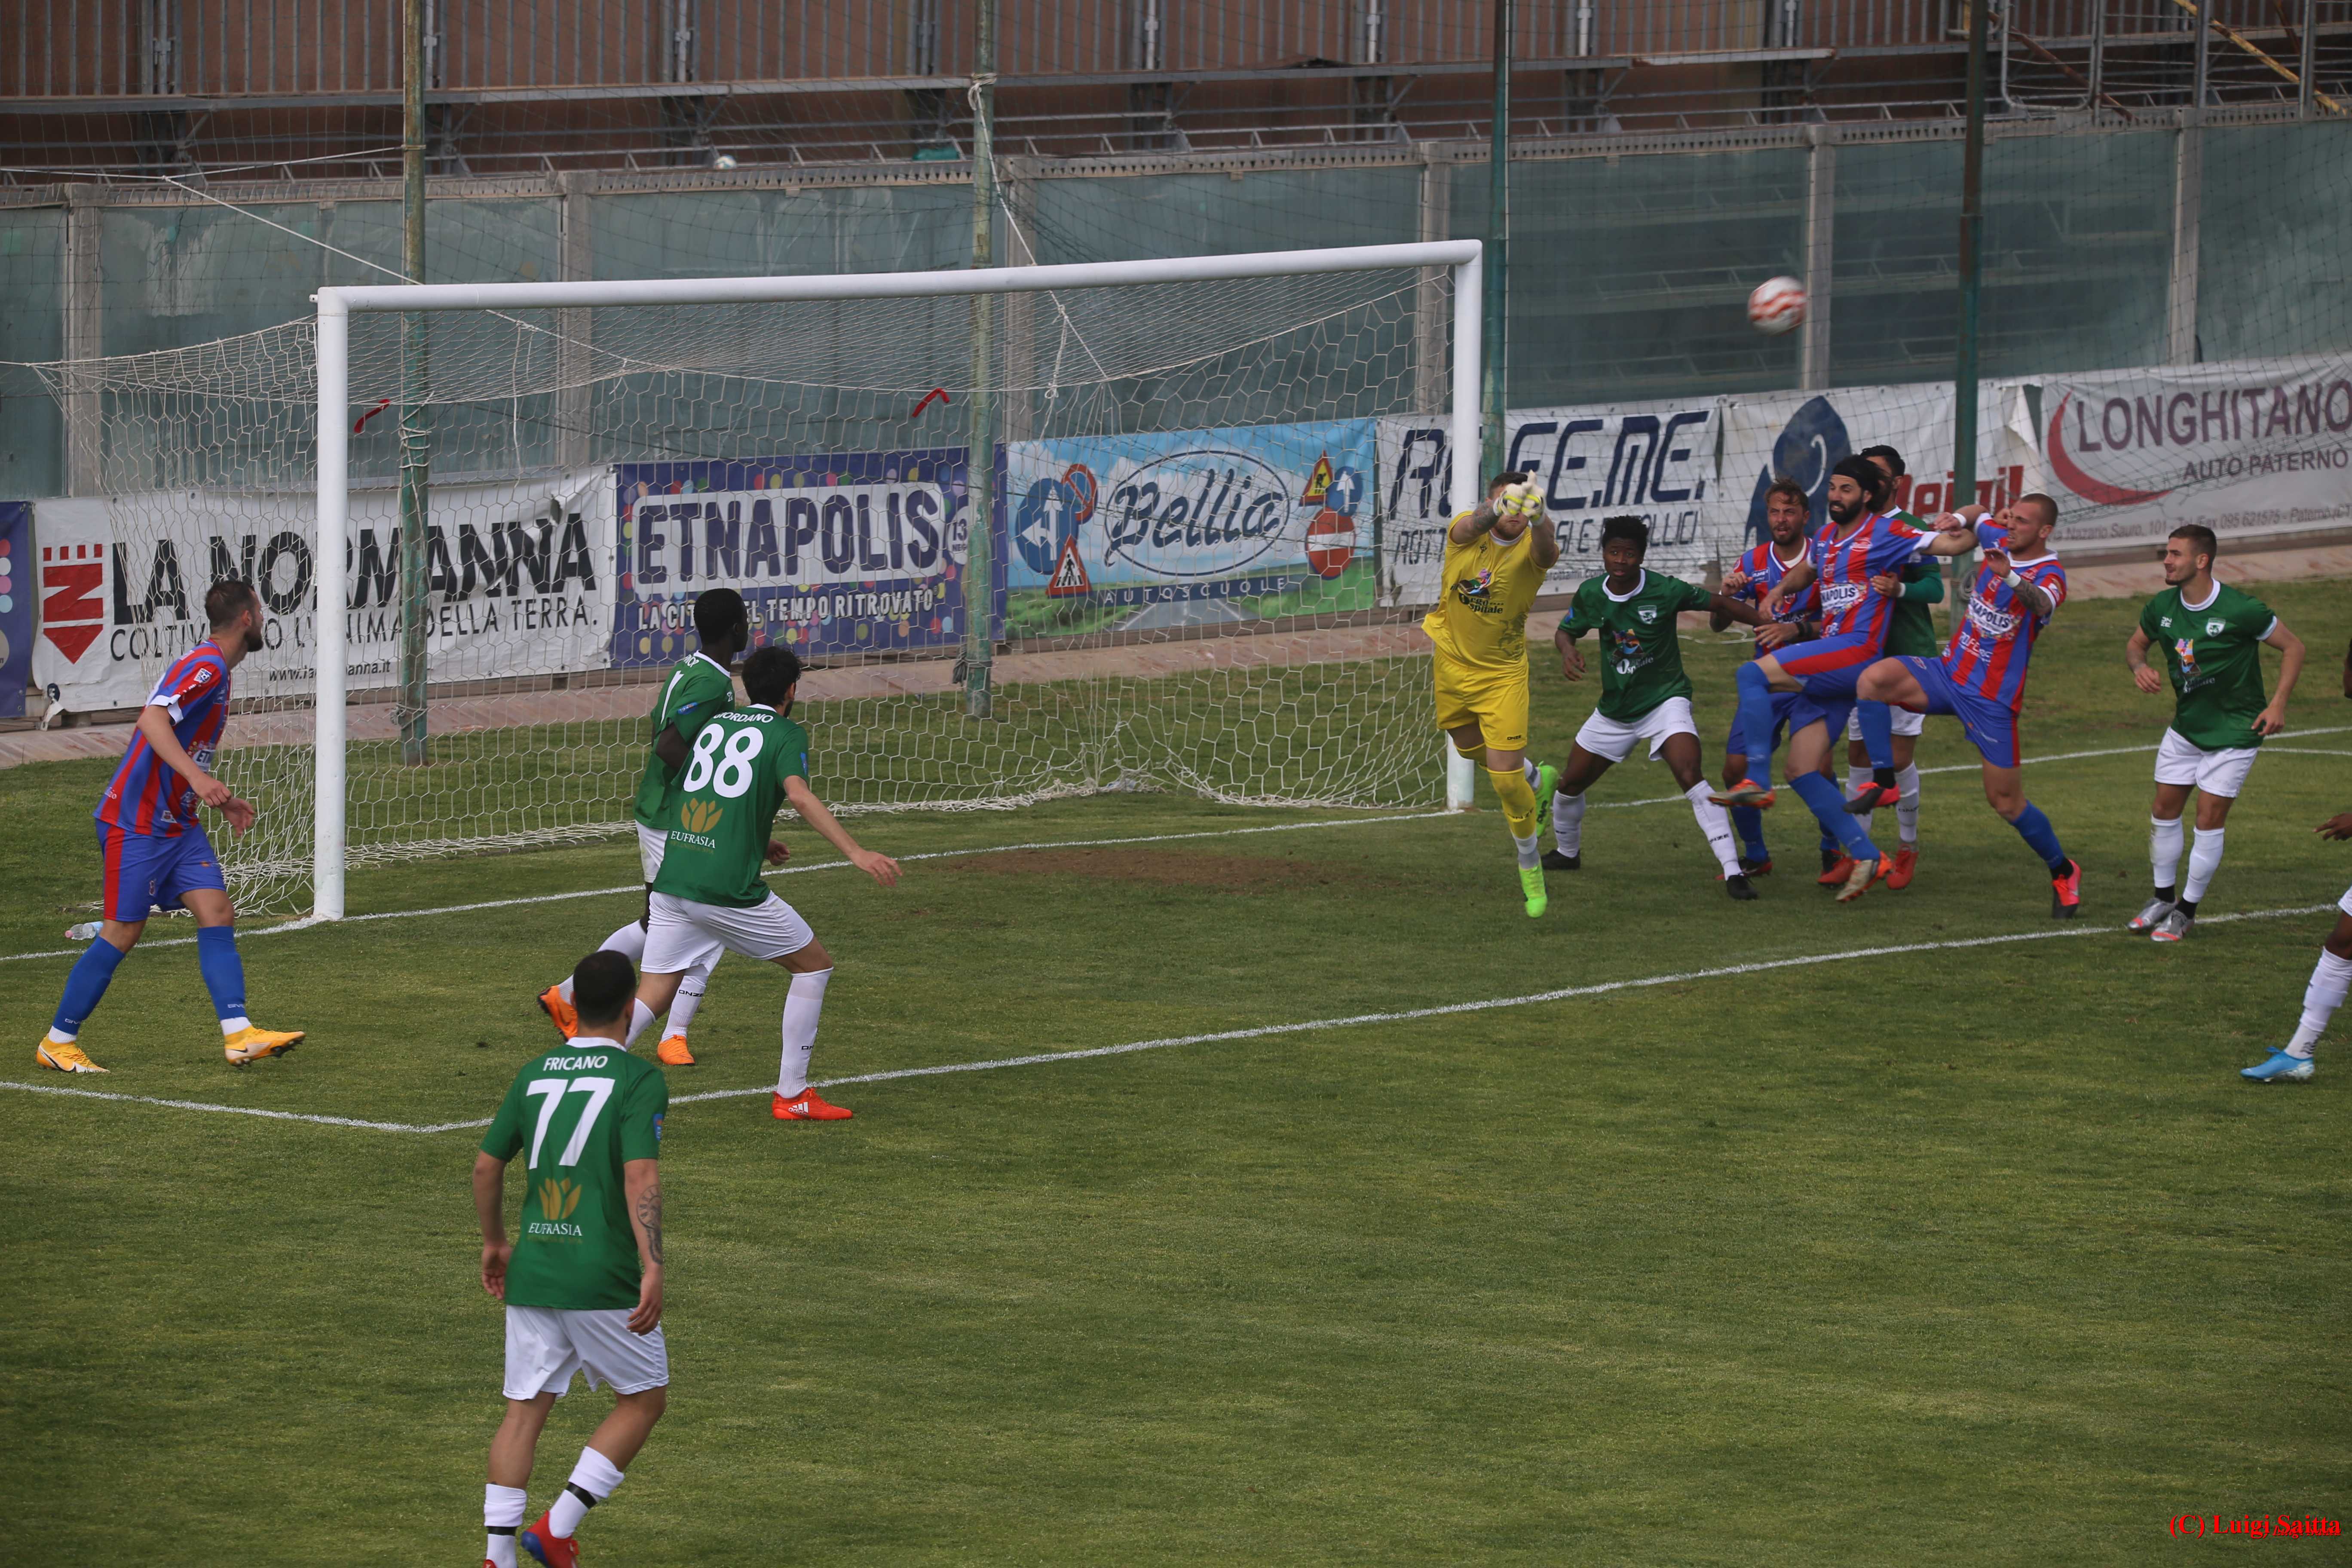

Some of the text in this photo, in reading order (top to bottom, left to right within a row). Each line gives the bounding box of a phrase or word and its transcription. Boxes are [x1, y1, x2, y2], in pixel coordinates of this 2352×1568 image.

[2077, 379, 2352, 452] LONGHITANO
[2183, 456, 2243, 481] AUTO
[1104, 468, 1284, 567] Bellia
[2150, 519, 2167, 536] 101
[638, 490, 939, 584] ETNAPOLIS
[112, 539, 190, 625] LA
[1104, 576, 1287, 604] AUTOSCUOLE
[511, 594, 597, 631] TERRA.
[638, 604, 661, 631] LA
[766, 595, 830, 622] TEMPO
[683, 723, 764, 798] 88
[671, 830, 716, 848] EUFRASIA
[543, 1055, 608, 1071] FRICANO
[526, 1077, 616, 1170] 77
[528, 1223, 583, 1236] EUFRASIA
